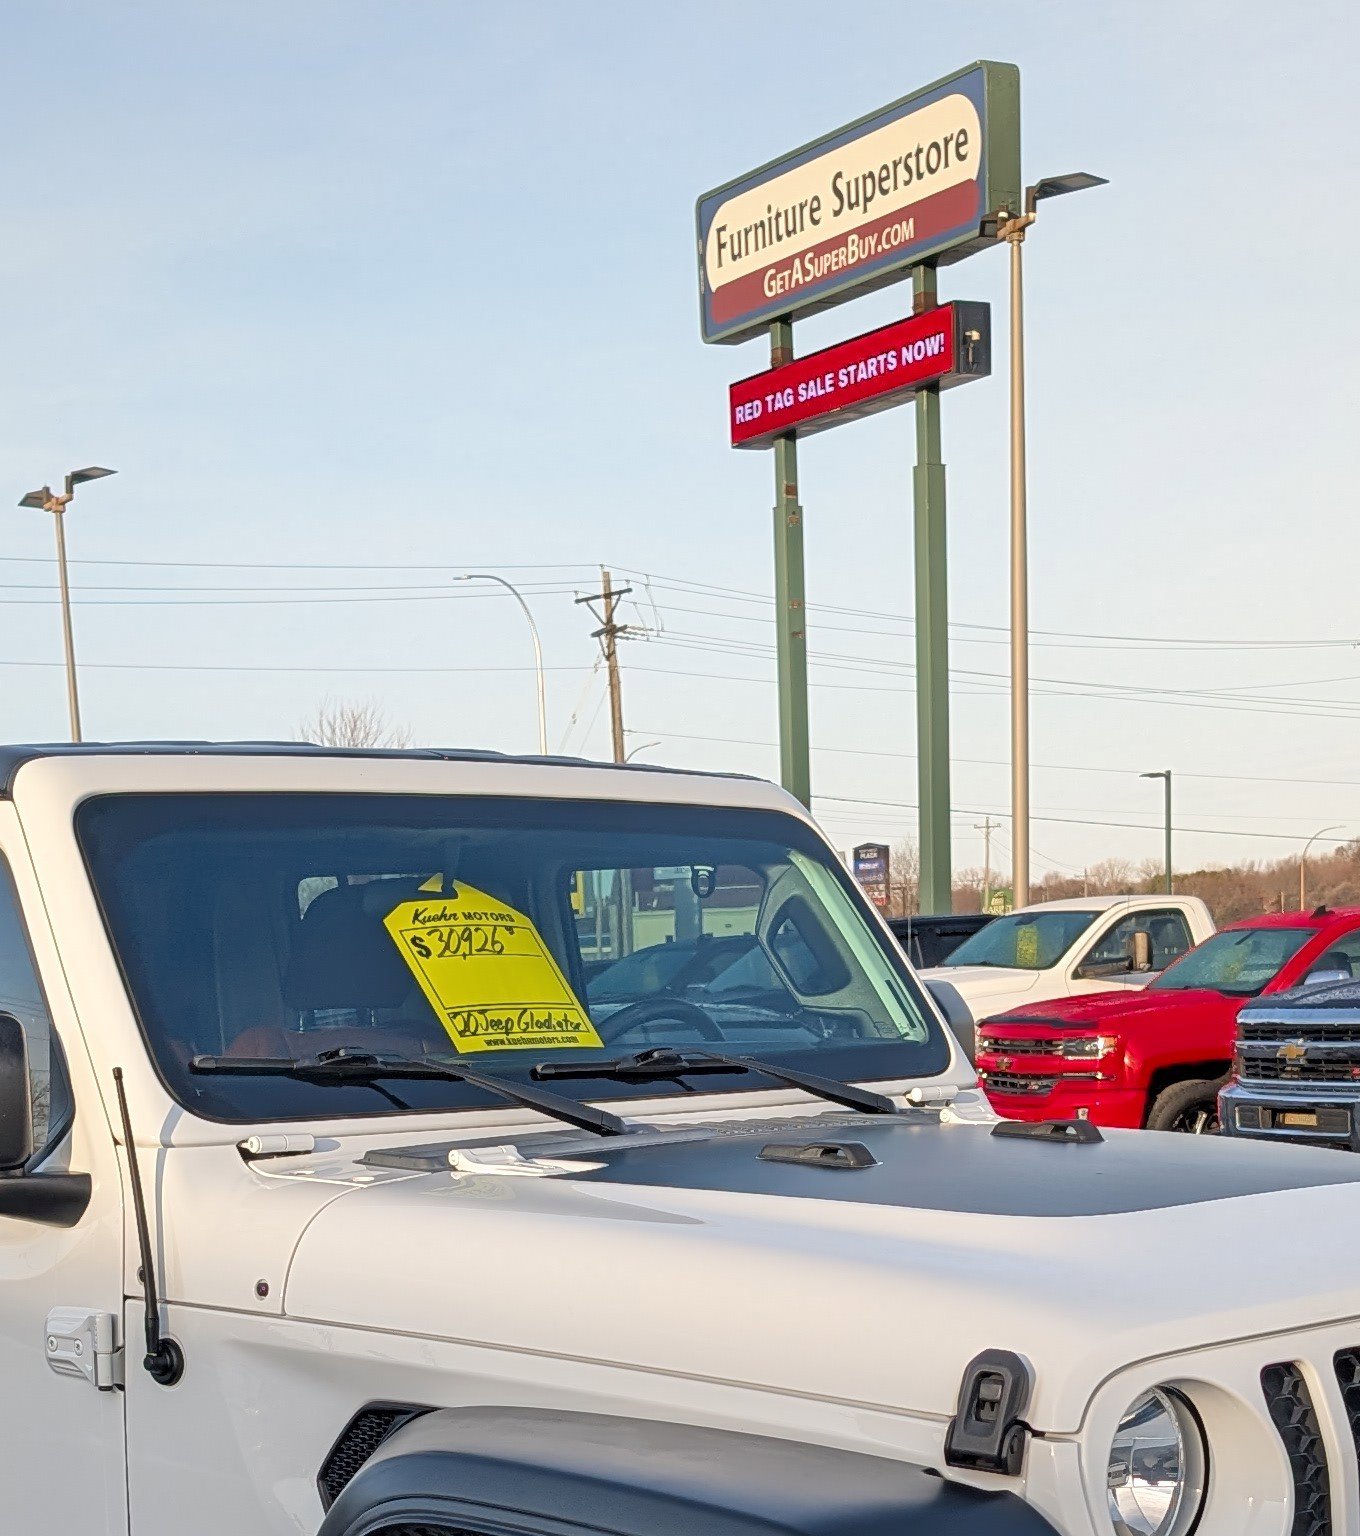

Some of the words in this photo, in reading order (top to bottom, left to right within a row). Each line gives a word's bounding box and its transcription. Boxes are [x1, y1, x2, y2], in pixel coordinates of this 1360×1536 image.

[714, 192, 823, 268] Furniture
[831, 127, 970, 218] Superstore
[735, 398, 763, 425] RED
[764, 386, 794, 415] TAG
[797, 373, 835, 402] SALE
[838, 350, 898, 393] STARTS
[901, 332, 945, 367] NOW!
[411, 906, 460, 925] Kuehn
[462, 911, 516, 923] MOTORS
[483, 1035, 579, 1047] www.kuehnmotors.com
